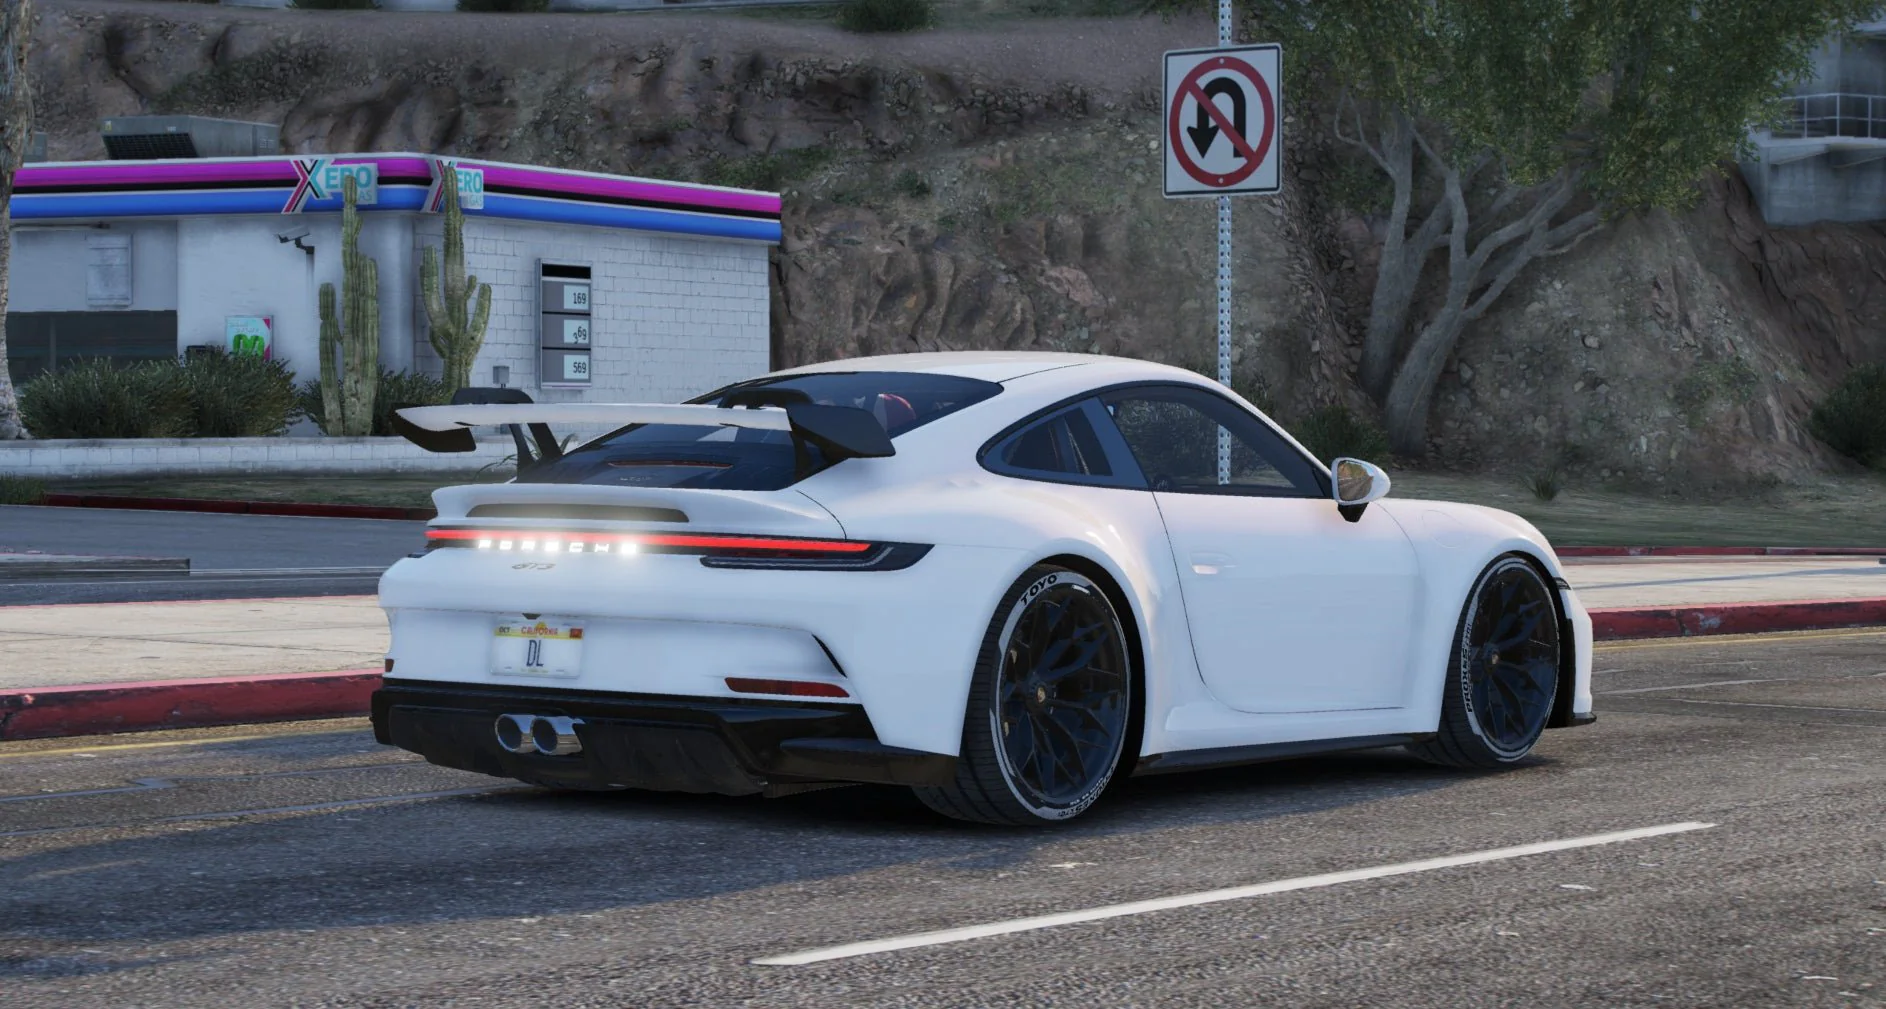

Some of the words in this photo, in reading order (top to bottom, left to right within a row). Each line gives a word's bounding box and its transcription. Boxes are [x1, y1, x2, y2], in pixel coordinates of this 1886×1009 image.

[572, 292, 587, 305] 169
[572, 326, 587, 345] 369
[572, 361, 587, 374] 569
[1020, 574, 1058, 606] TOYO
[526, 639, 544, 668] DL
